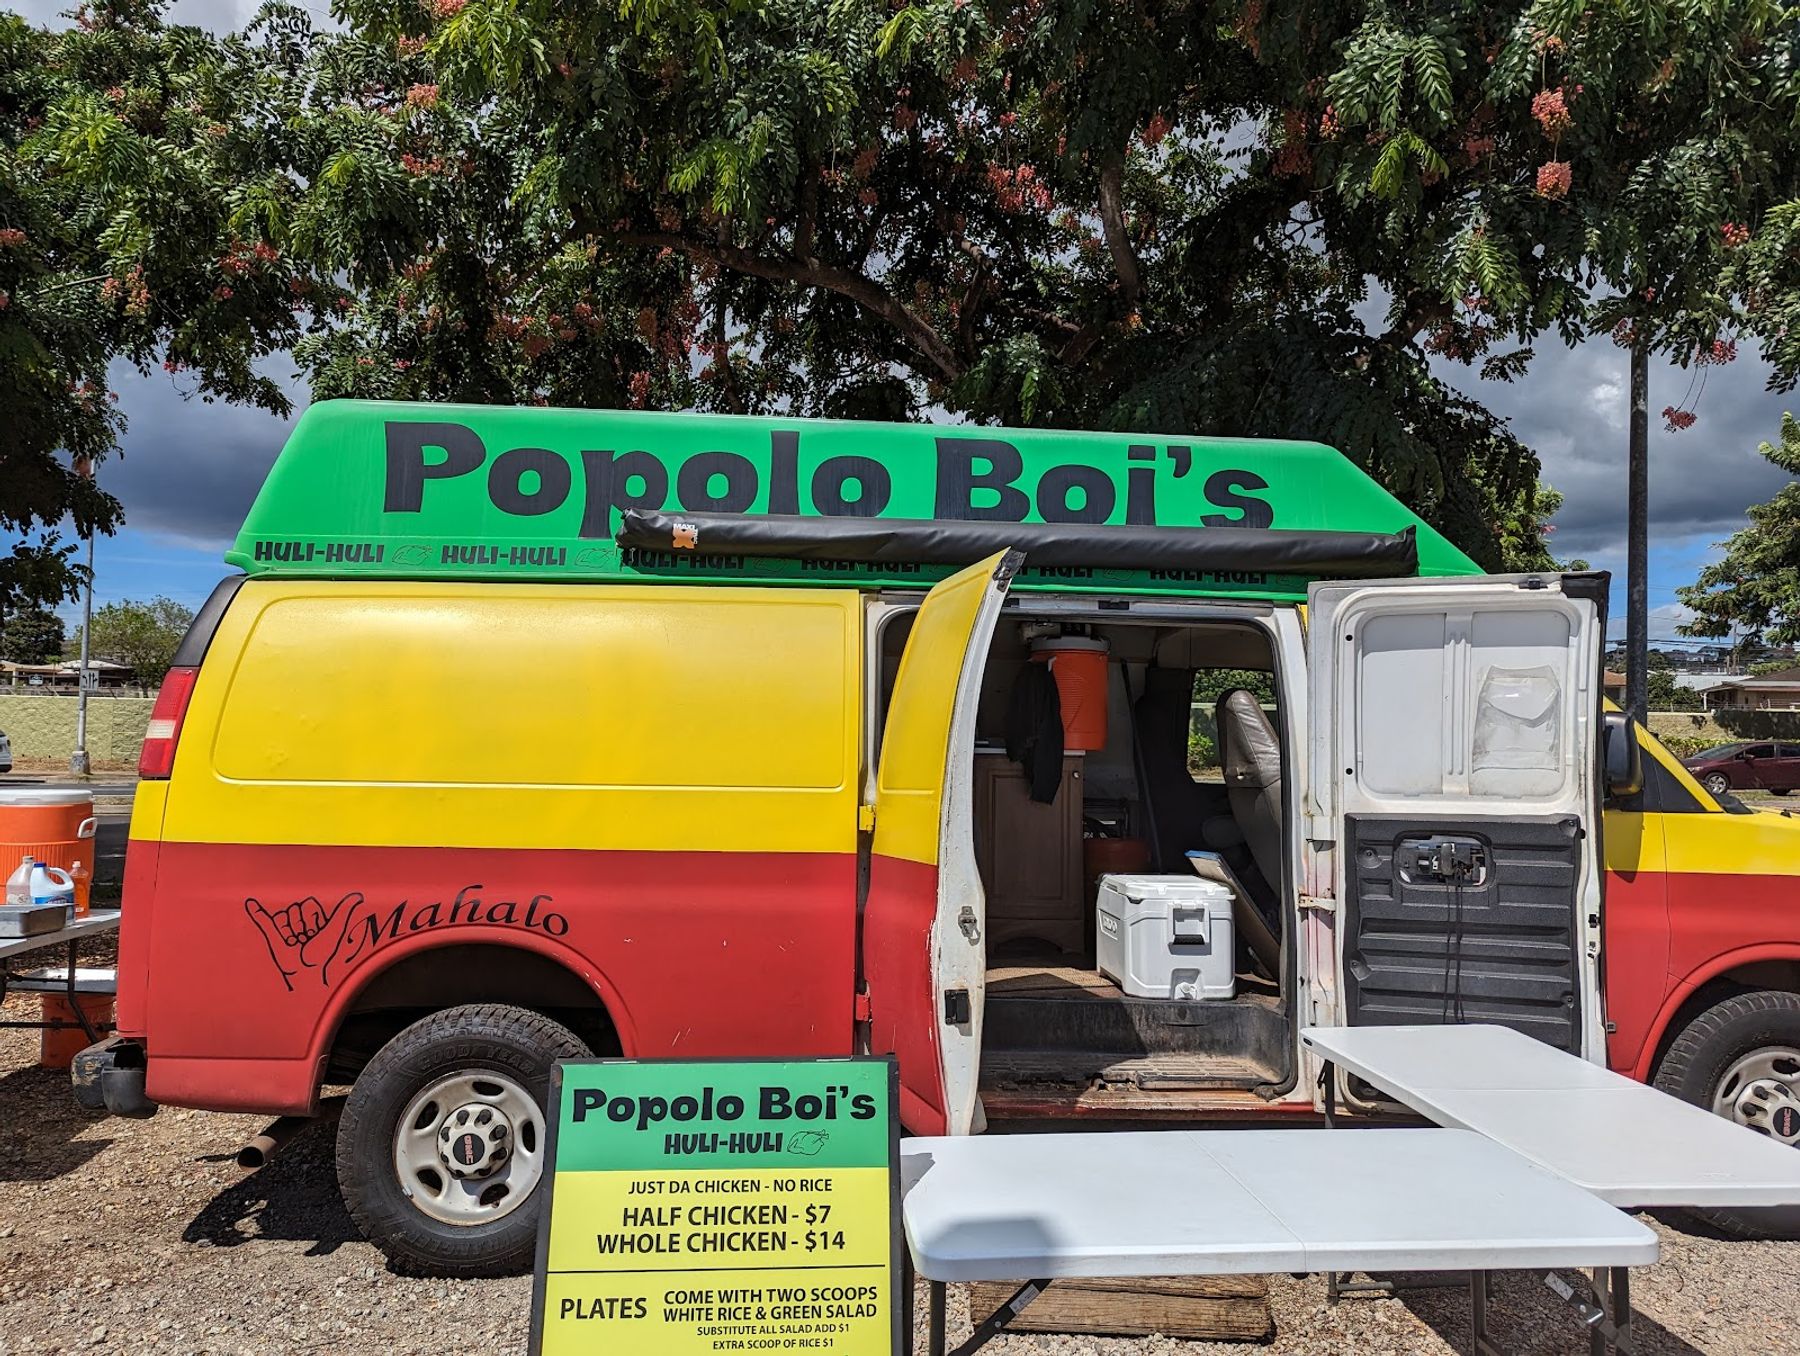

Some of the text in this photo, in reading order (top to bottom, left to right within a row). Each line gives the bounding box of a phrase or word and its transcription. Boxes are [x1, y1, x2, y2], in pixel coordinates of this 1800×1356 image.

[384, 421, 1274, 538] Popolo Boi's
[255, 541, 384, 563] HULI-HULI
[441, 545, 567, 566] HULI-HULI
[345, 884, 569, 963] Mahalo
[573, 1086, 876, 1130] Popolo Boi's
[664, 1132, 783, 1154] HULI-HULI
[629, 1181, 665, 1194] JUST
[669, 1181, 690, 1193] DA
[695, 1180, 760, 1193] CHICKEN
[774, 1179, 796, 1192] NO
[800, 1179, 832, 1191] RICE
[623, 1207, 681, 1226] HALF
[688, 1205, 786, 1225] CHICKEN
[806, 1203, 831, 1225] $7
[597, 1233, 680, 1253] WHOLE
[687, 1231, 786, 1252] CHICKEN
[805, 1230, 845, 1252] $14
[664, 1287, 877, 1304] COME WITH TWO SCOOPS
[561, 1298, 647, 1319] PLATES
[664, 1304, 876, 1322] WHITE RICE & GREEN SALAD
[697, 1323, 848, 1335] SUBSTITUTE ALL SALAD ADD $1
[713, 1338, 832, 1349] EXTRA SCOOP OF RICE $1
